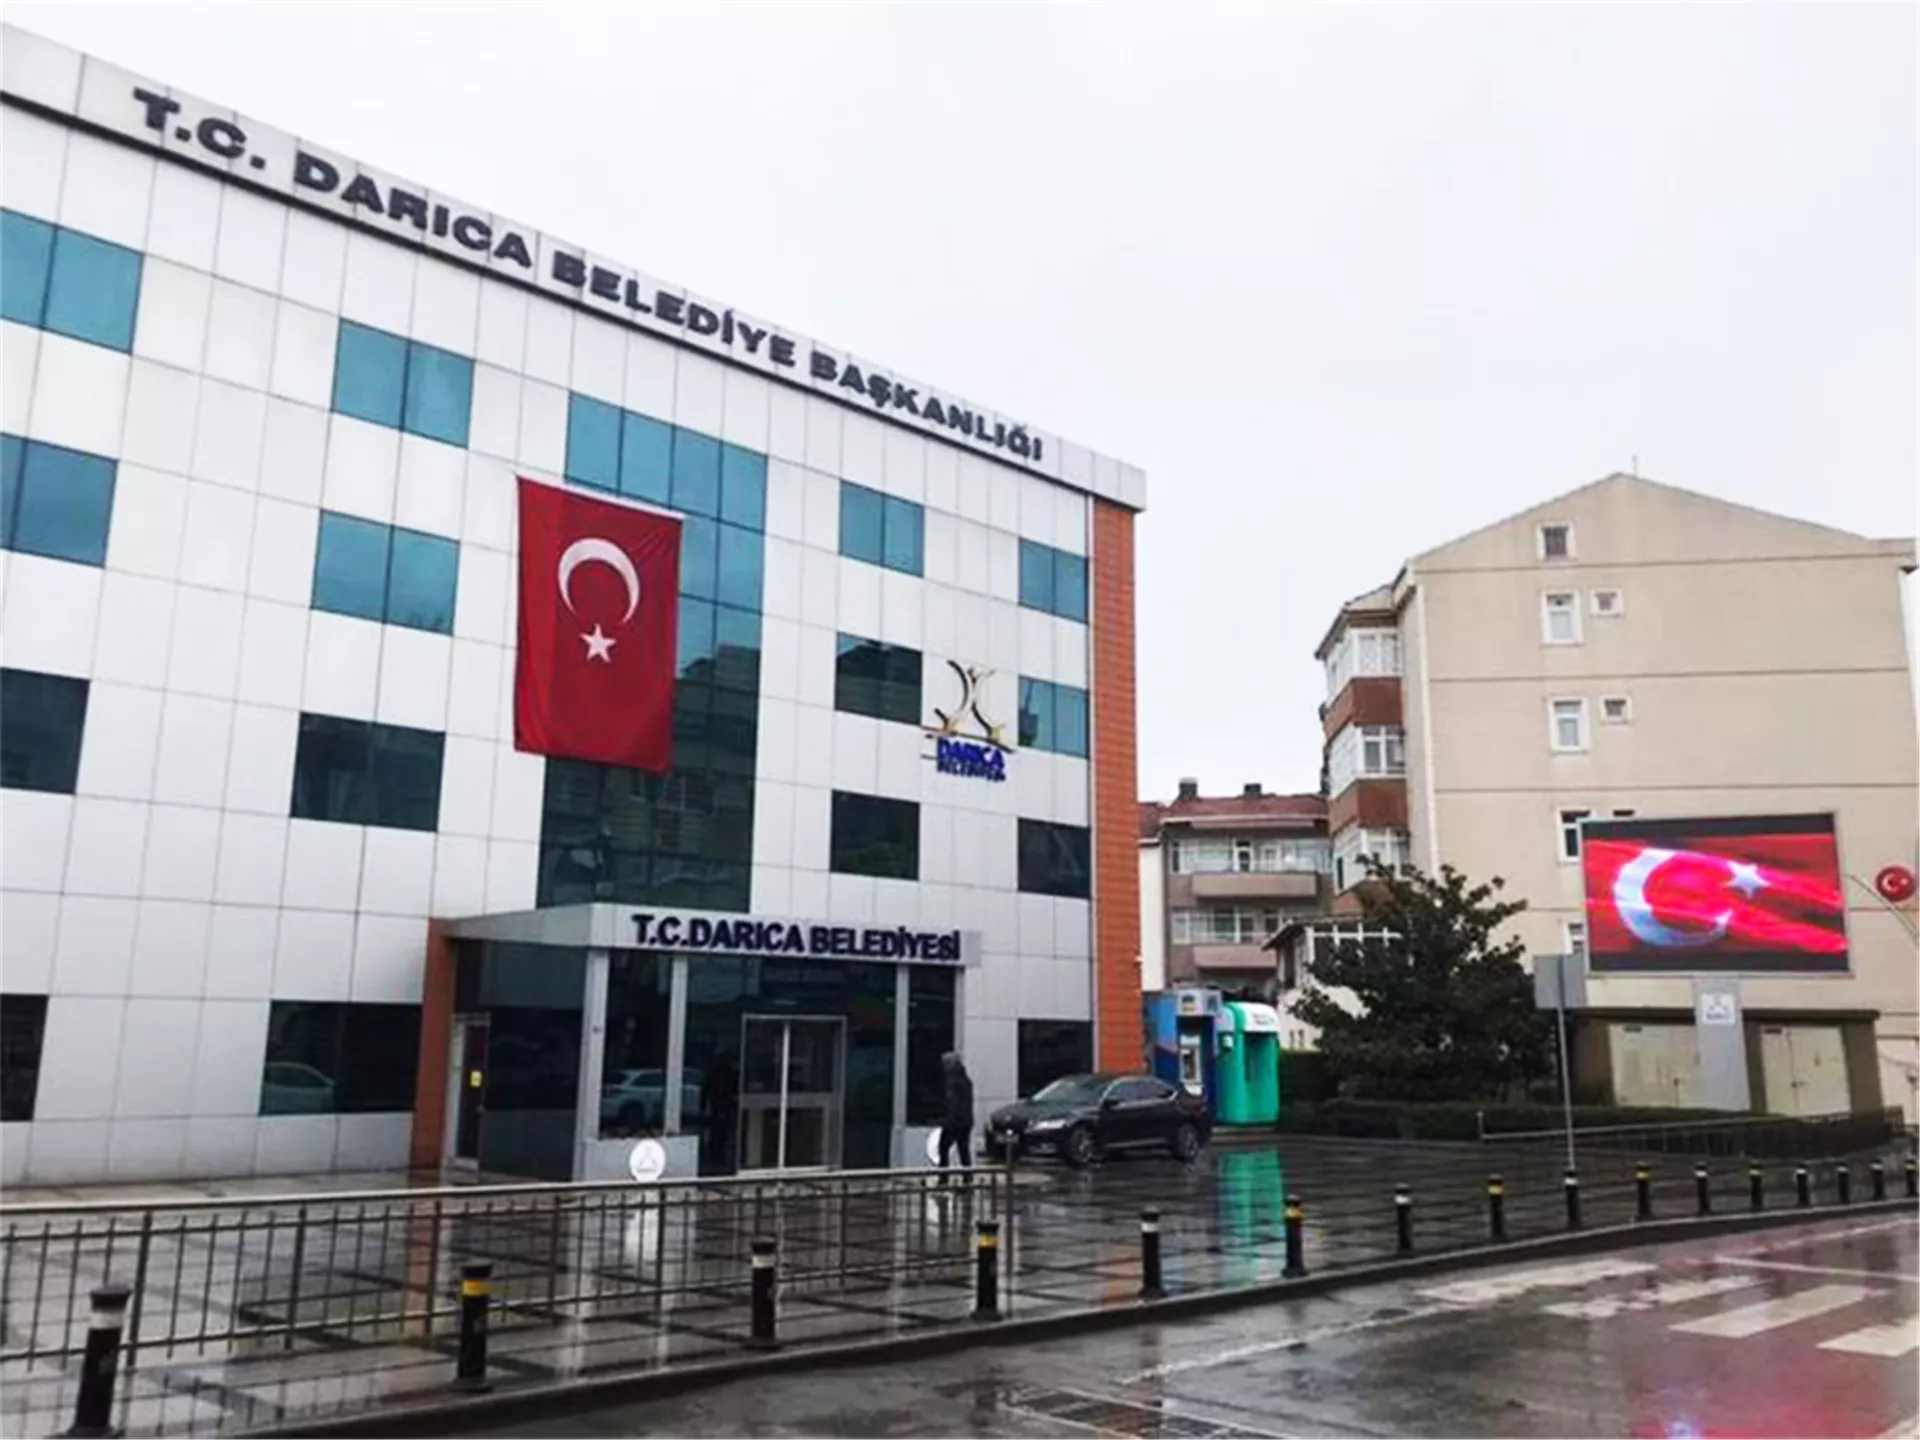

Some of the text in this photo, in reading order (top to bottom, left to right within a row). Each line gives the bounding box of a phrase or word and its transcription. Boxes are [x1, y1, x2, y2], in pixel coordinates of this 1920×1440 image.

[133, 86, 1044, 461] T.C. DARICA BELEDİYE BAŞKANLIĞI
[808, 926, 961, 961] BELEDİYESİ
